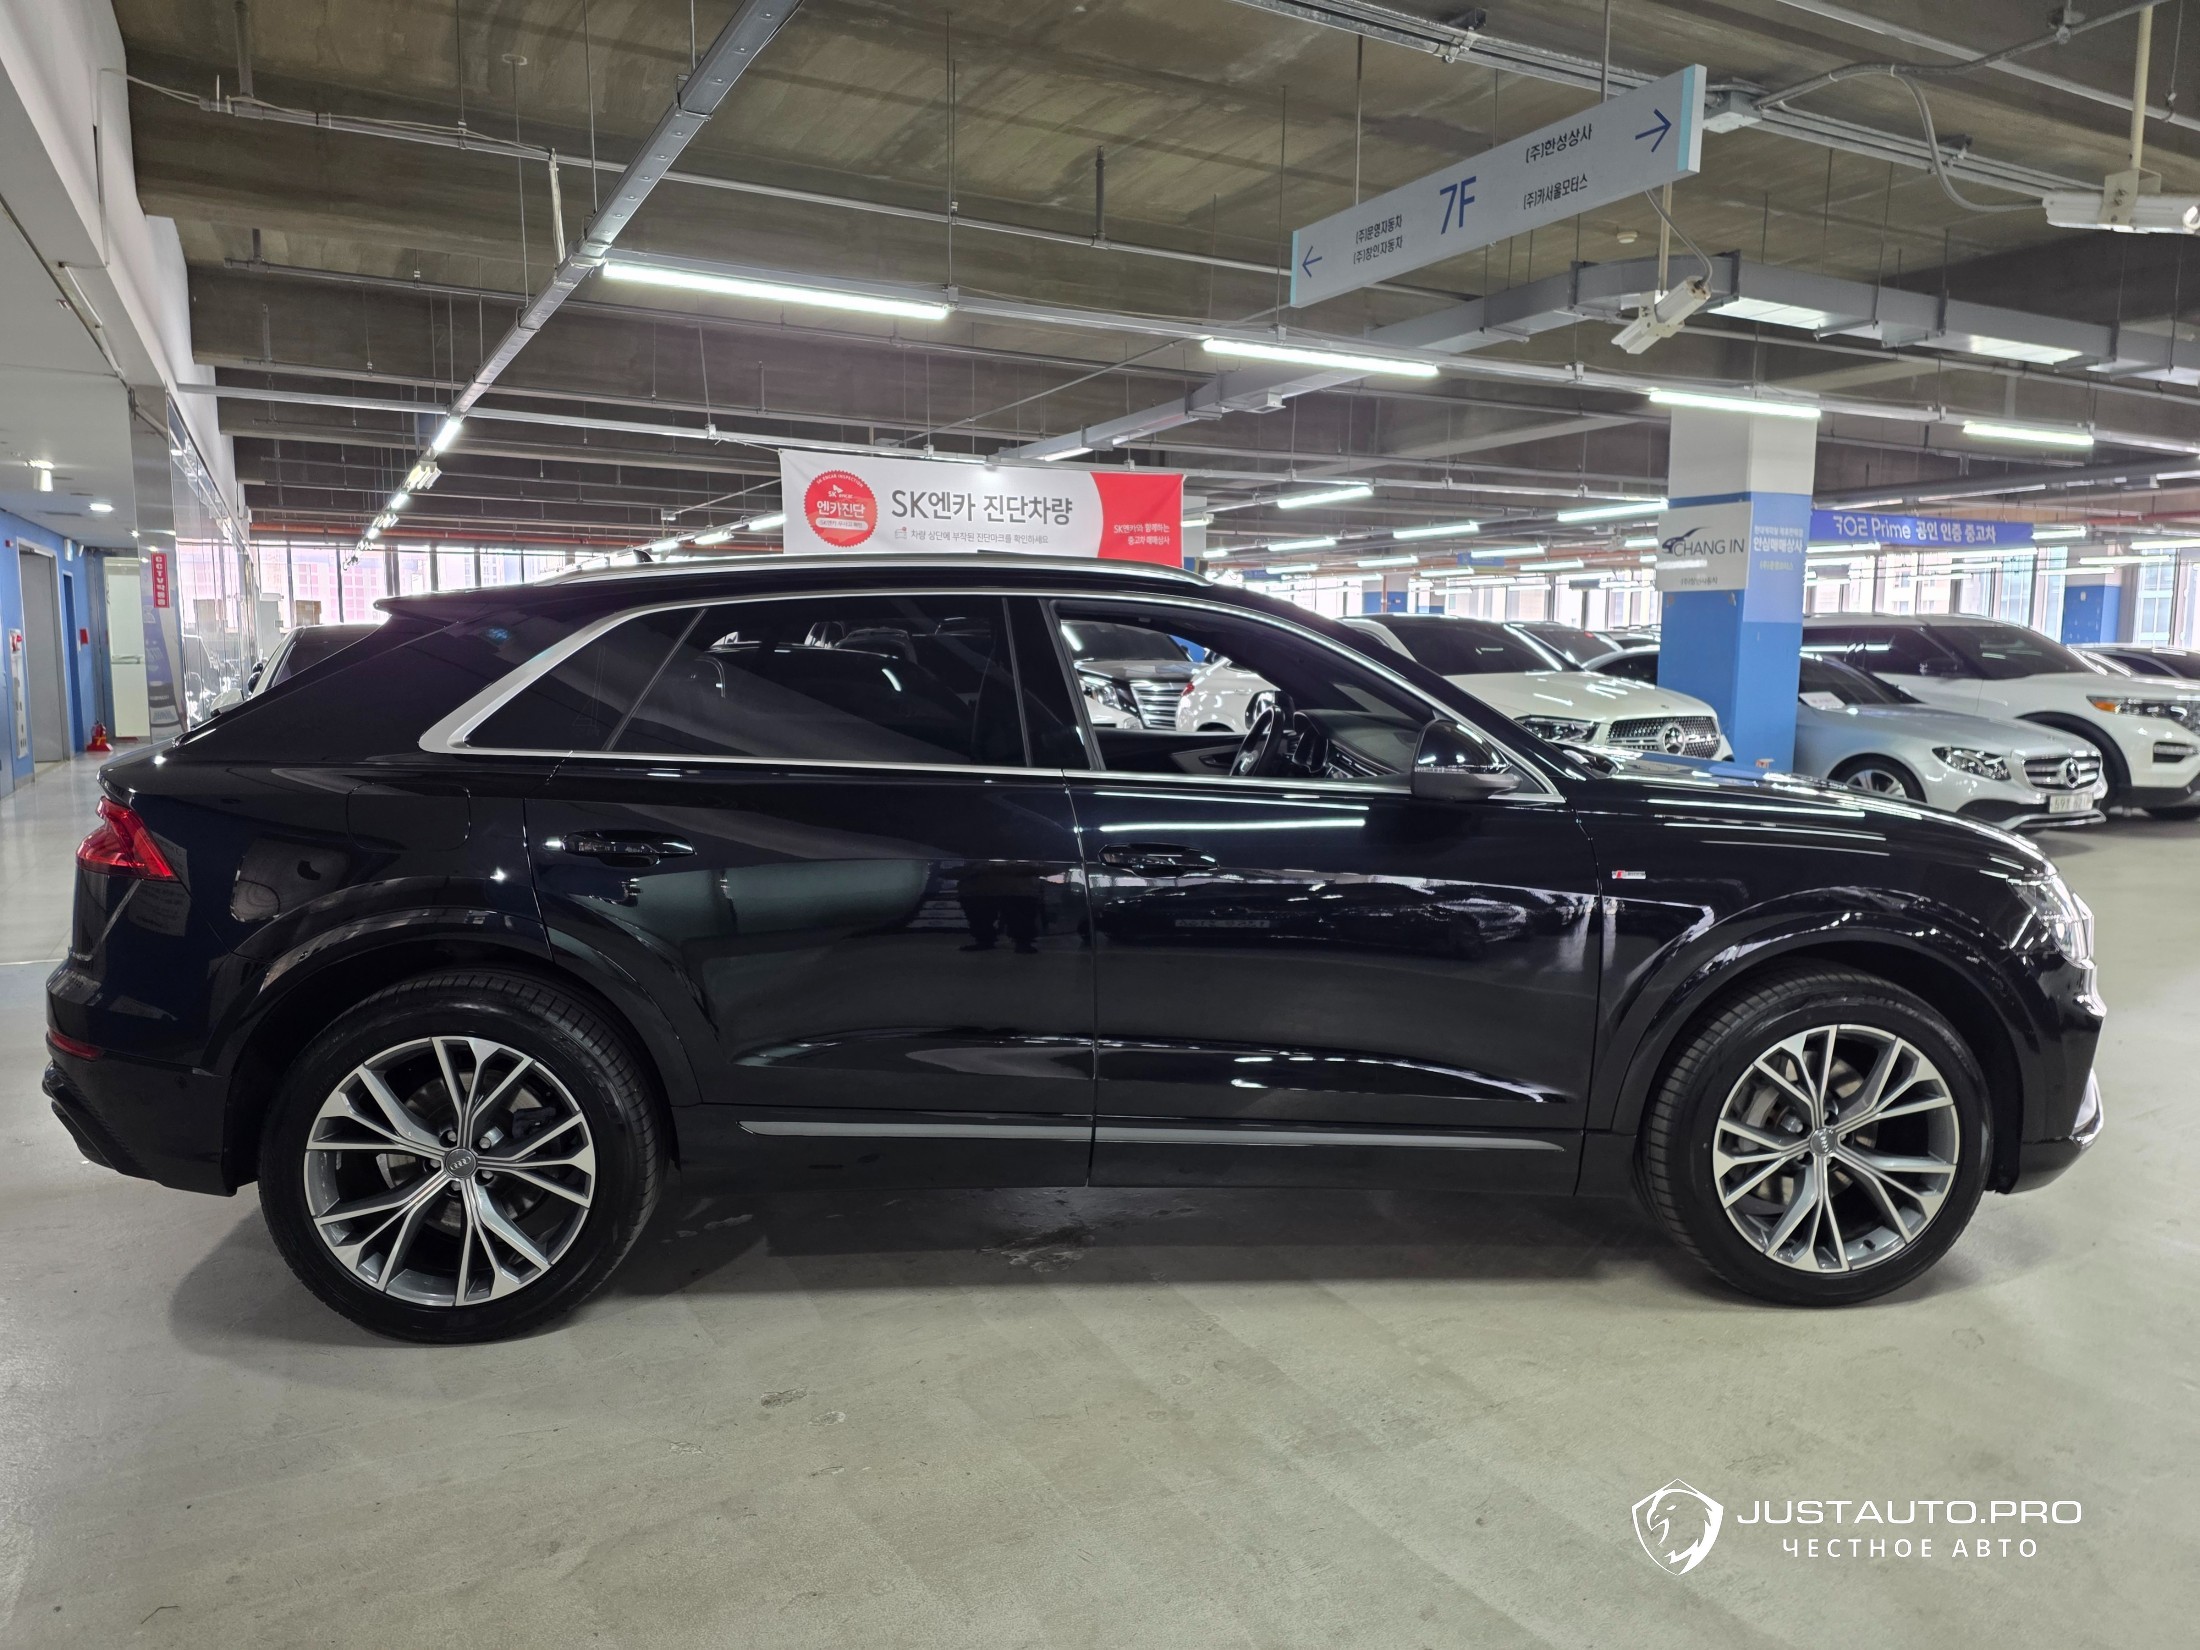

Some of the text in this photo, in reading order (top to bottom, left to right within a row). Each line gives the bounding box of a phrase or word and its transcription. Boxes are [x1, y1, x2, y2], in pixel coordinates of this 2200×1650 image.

[1525, 123, 1593, 164] (주)한성상사
[1523, 173, 1588, 210] (주)카서울모터스
[1440, 175, 1477, 235] 7F
[828, 490, 837, 498] SK
[816, 500, 865, 518] 엔카진단
[891, 489, 1073, 526] SK엔카 진단차량
[911, 529, 1049, 545] 차량 상단에 부착된 진단마크를 확인하세요
[1113, 524, 1144, 534] SK엔카와
[1871, 517, 1912, 540] Prime
[1916, 520, 1939, 541] 공인
[1940, 521, 1962, 543] 인증
[1965, 524, 1996, 545] 중고차
[1673, 538, 1745, 557] CHANG IN
